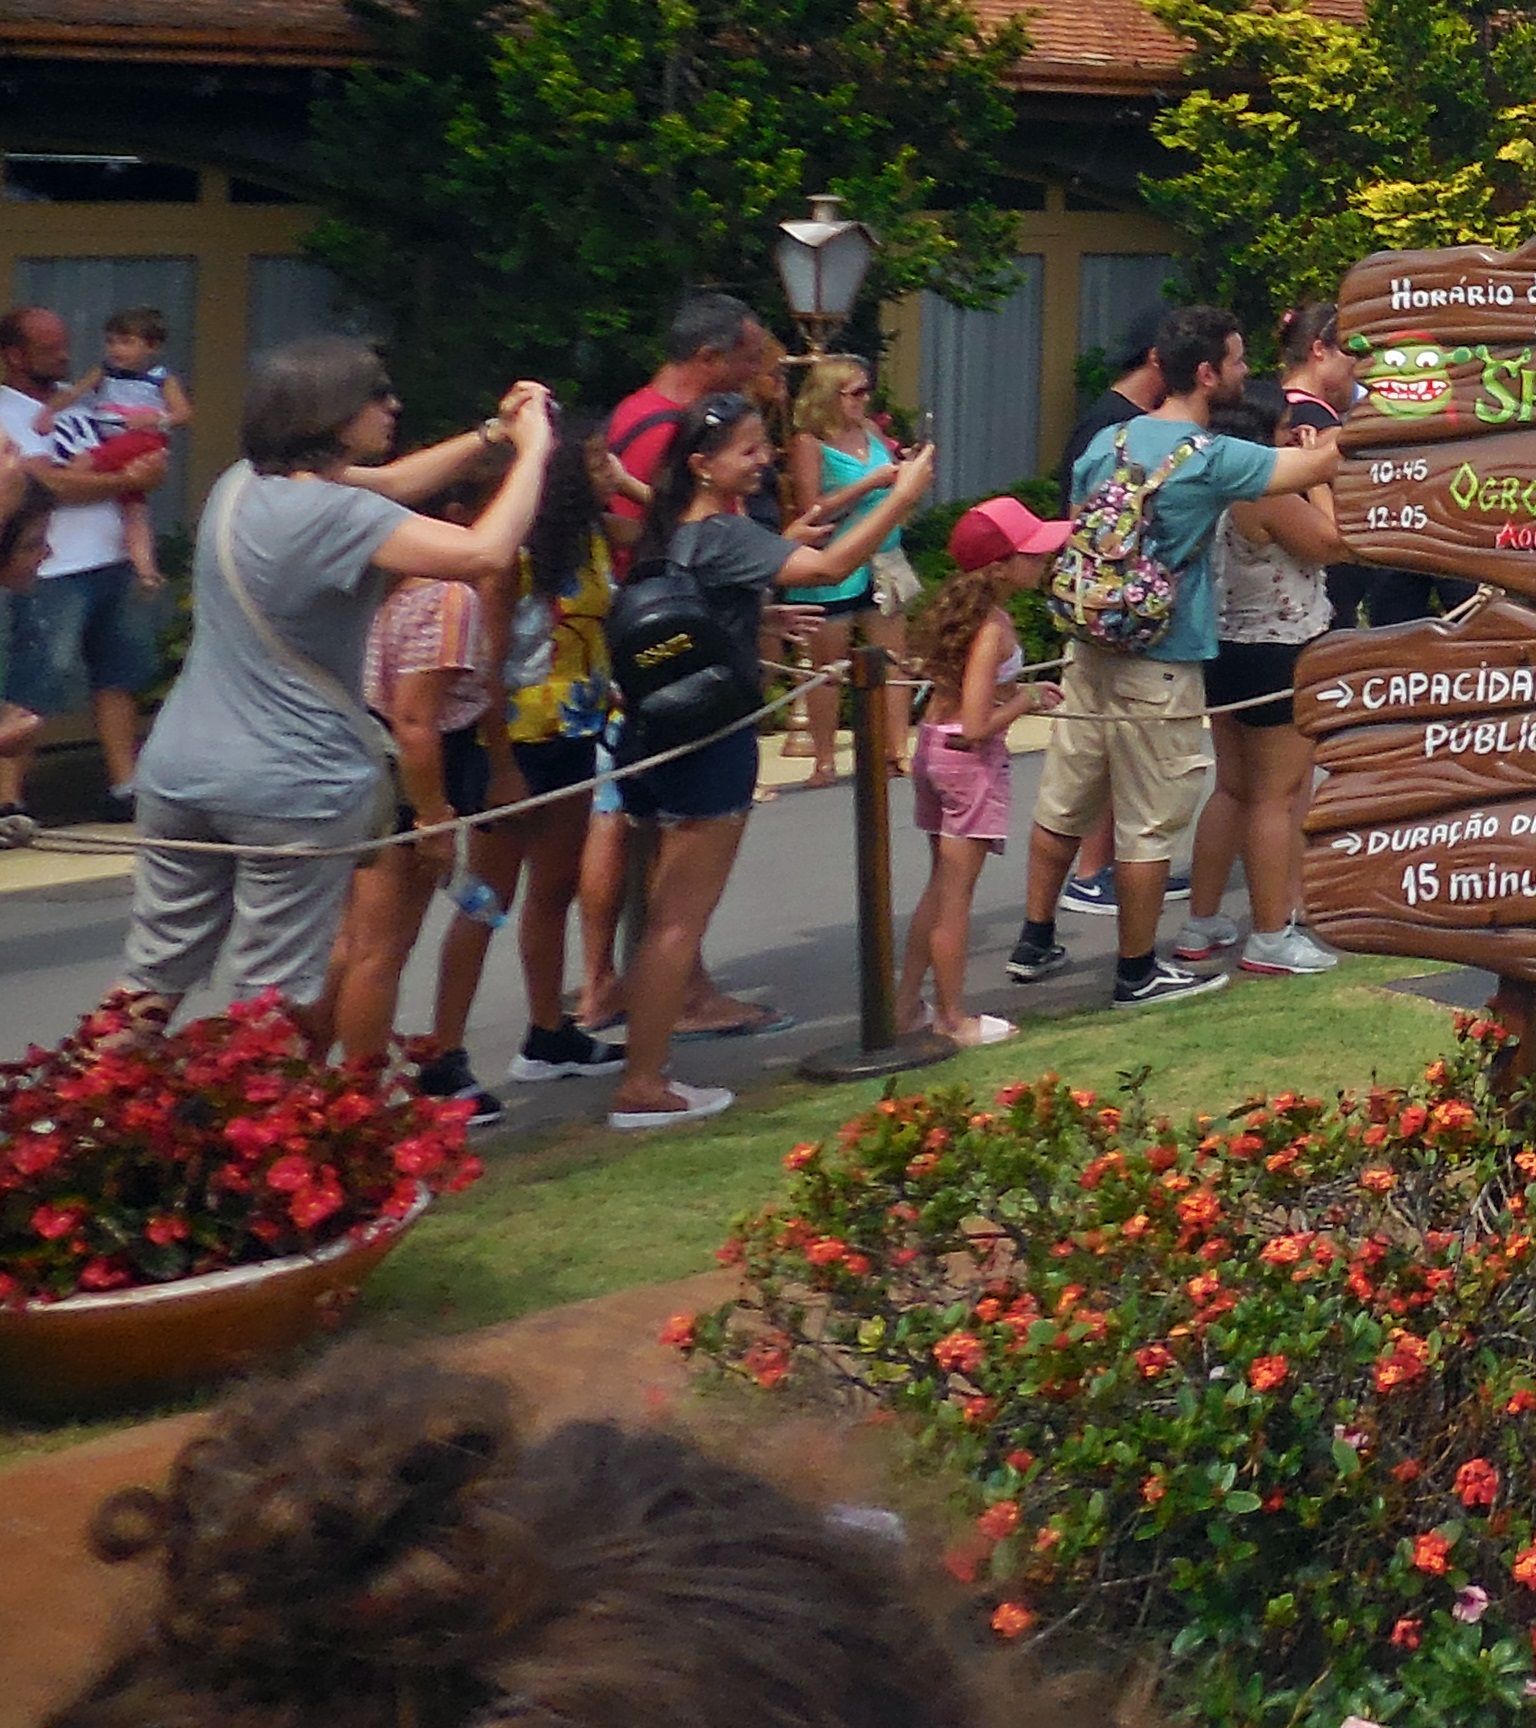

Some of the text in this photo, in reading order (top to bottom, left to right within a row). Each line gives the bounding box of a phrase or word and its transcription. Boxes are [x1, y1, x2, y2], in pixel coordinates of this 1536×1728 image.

[1368, 457, 1428, 483] 10:45
[1366, 506, 1428, 531] 12:05
[1366, 812, 1499, 855] DURAÇÃO
[1401, 862, 1440, 906] 15
